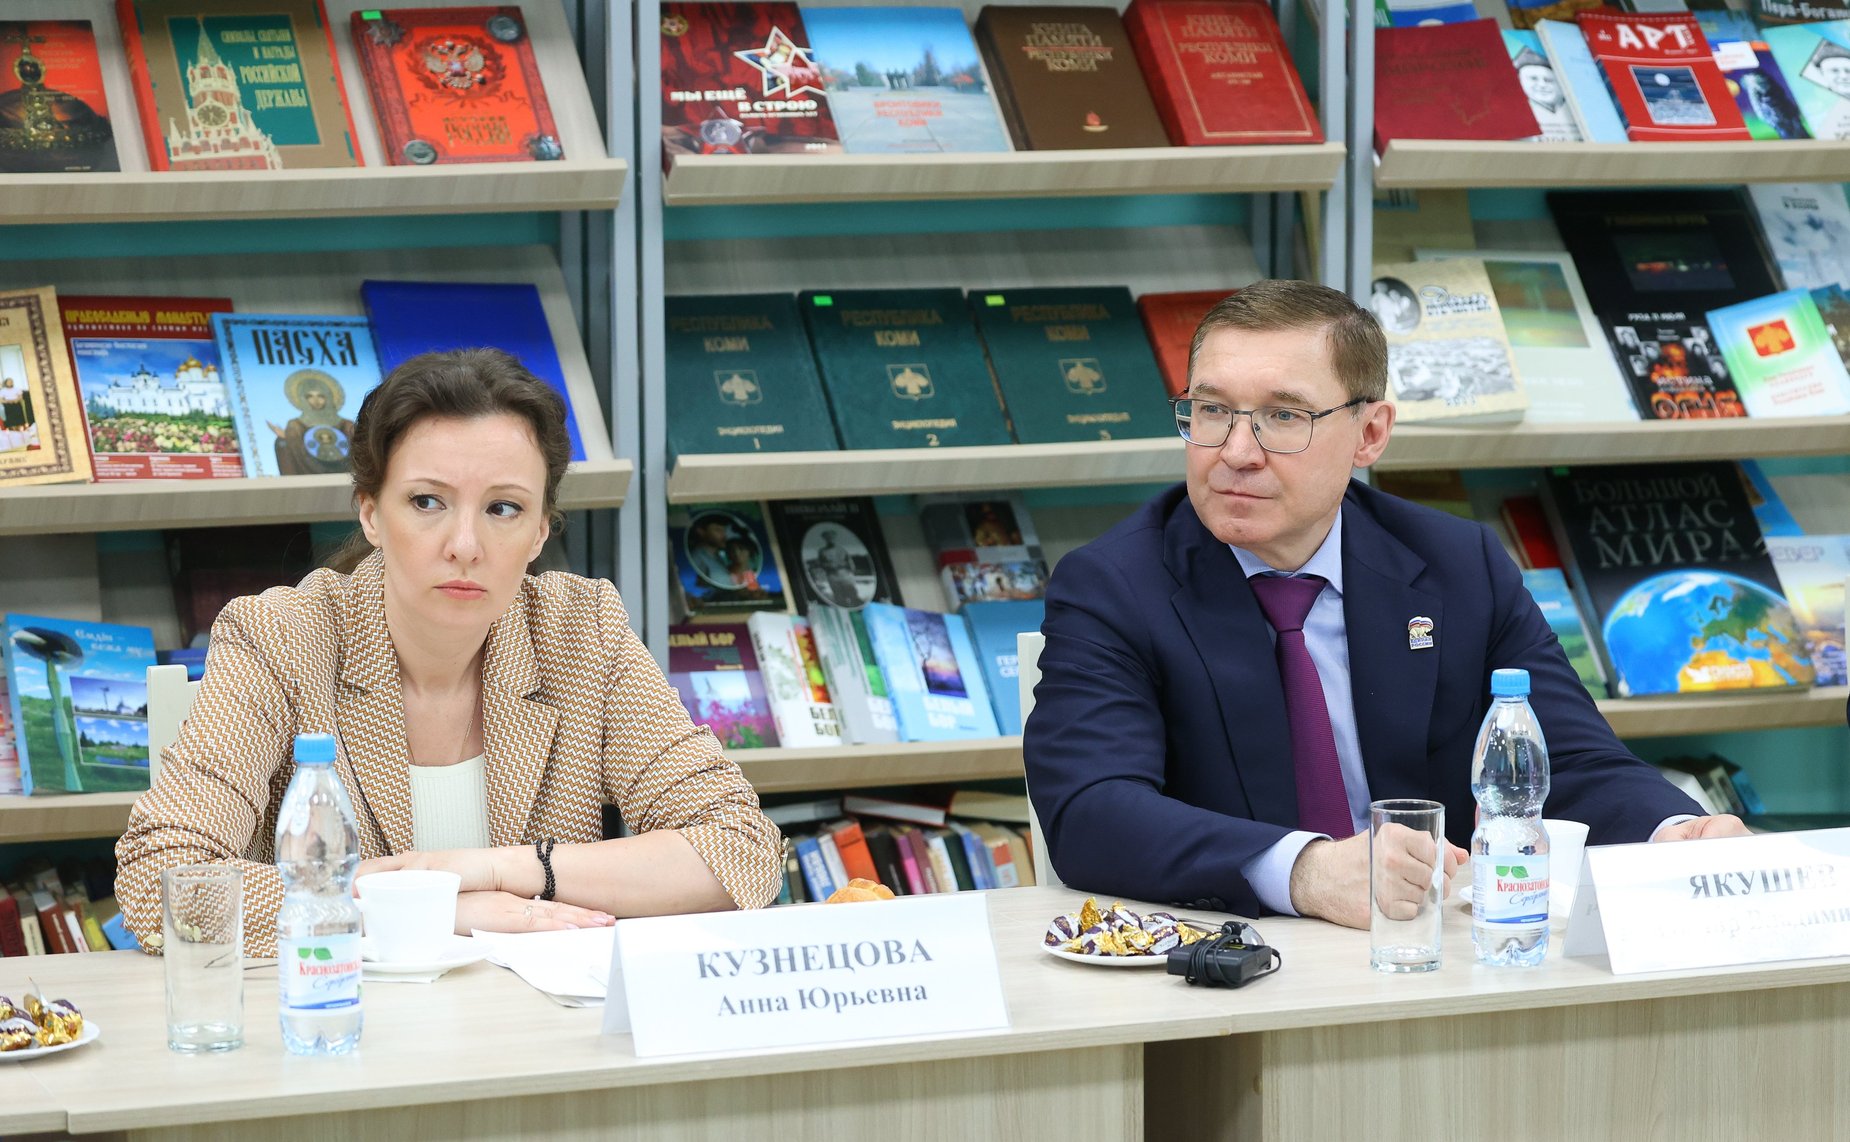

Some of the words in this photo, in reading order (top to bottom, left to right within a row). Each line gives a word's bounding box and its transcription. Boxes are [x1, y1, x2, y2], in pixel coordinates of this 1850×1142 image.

[1616, 23, 1690, 50] АРТ
[1046, 59, 1097, 71] КОМИ
[1204, 52, 1257, 64] КОМИ
[239, 63, 301, 84] РОССИЙСКОЙ
[255, 88, 308, 110] ДЕРЖАВЫ
[670, 91, 702, 101] МЫ
[704, 88, 747, 101] ЕЩЁ
[737, 101, 751, 112] В
[753, 100, 818, 112] СТРОЮ
[874, 330, 920, 346] КОМИ
[1045, 325, 1090, 341] КОМИ
[252, 329, 358, 366] ПАСХА
[704, 336, 749, 352] КОМИ
[1650, 389, 1747, 419] ОГНЯ
[754, 437, 760, 449] 1
[926, 434, 939, 446] 2
[1573, 474, 1723, 504] БОЛЬШОЙ
[1588, 499, 1736, 534] АТЛАС
[1591, 528, 1749, 568] МИРА
[1768, 546, 1824, 563] ЕВЕР
[1689, 864, 1836, 899] ЯКУШЕВ
[697, 938, 934, 979] КУЗНЕЦОВА
[717, 992, 790, 1017] Анна
[798, 981, 929, 1015] Юрьевна
